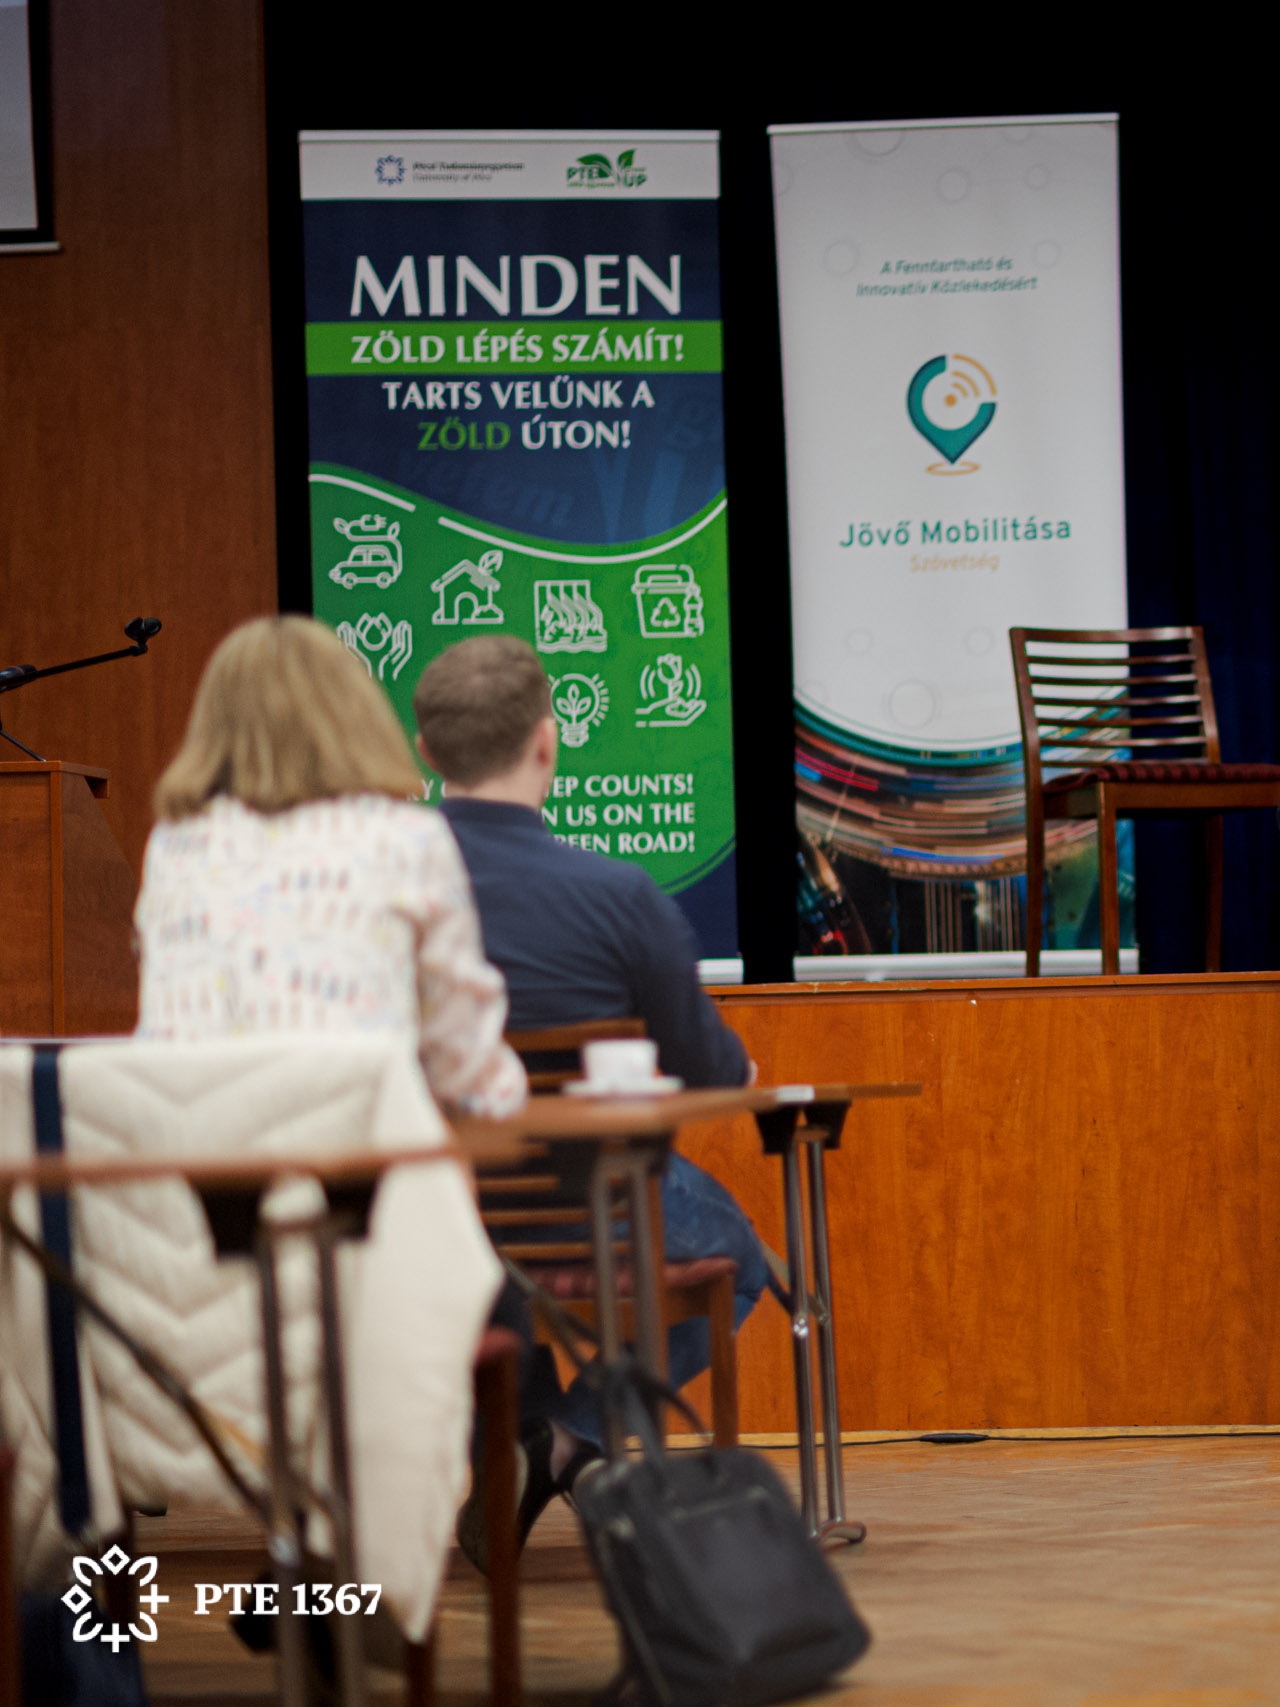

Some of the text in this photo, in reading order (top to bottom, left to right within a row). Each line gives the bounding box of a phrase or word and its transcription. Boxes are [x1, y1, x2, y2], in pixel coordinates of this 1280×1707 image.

[879, 260, 892, 274] A
[996, 256, 1013, 271] és
[350, 254, 681, 316] MINDEN
[351, 327, 684, 363] ZÖLD LÉPÉS SZÁMÍT!
[381, 381, 482, 410] TARTS
[630, 380, 656, 408] A
[417, 414, 631, 451] ZÖLD ÚTON!
[839, 515, 1073, 547] Jövő Mobilitása
[584, 773, 693, 797] COUNTS!
[566, 804, 597, 827] US
[603, 804, 643, 826] ON
[649, 802, 695, 824] THE
[618, 831, 695, 855] ROAD!
